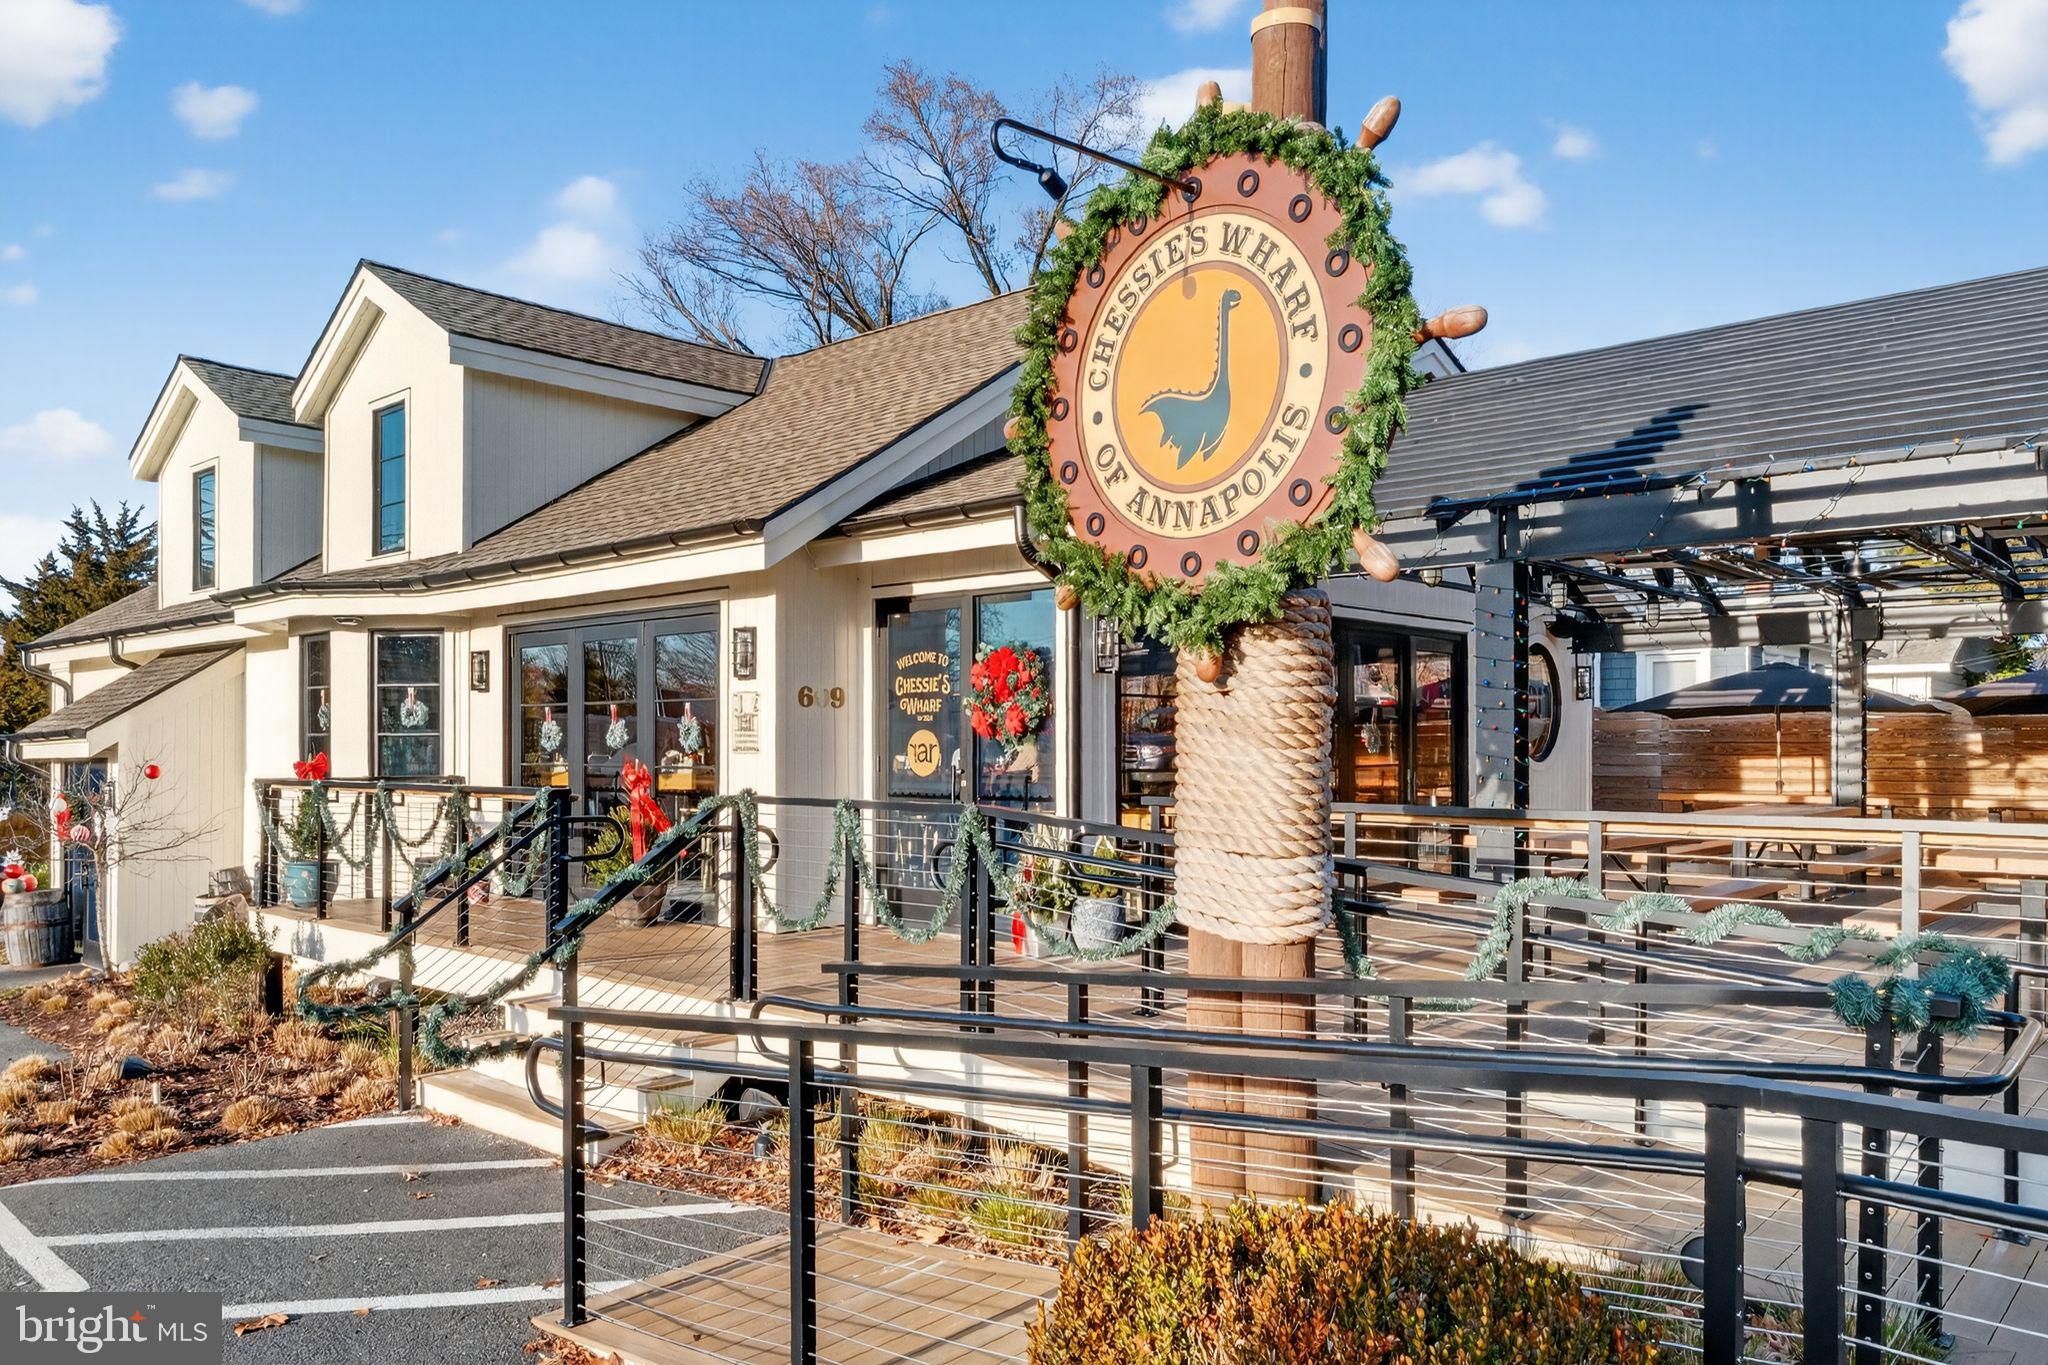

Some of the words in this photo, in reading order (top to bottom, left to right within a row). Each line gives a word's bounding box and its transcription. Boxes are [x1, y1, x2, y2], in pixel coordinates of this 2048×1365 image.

[1089, 224, 1208, 390] CHESSIE'S
[1219, 221, 1318, 342] WHARF
[1095, 444, 1129, 489] OF
[1126, 403, 1310, 531] ANNAPOLIS
[896, 651, 937, 670] WELCOME
[938, 653, 949, 667] TO
[895, 672, 951, 696] CHESSIE'S
[900, 697, 942, 715] WHARF
